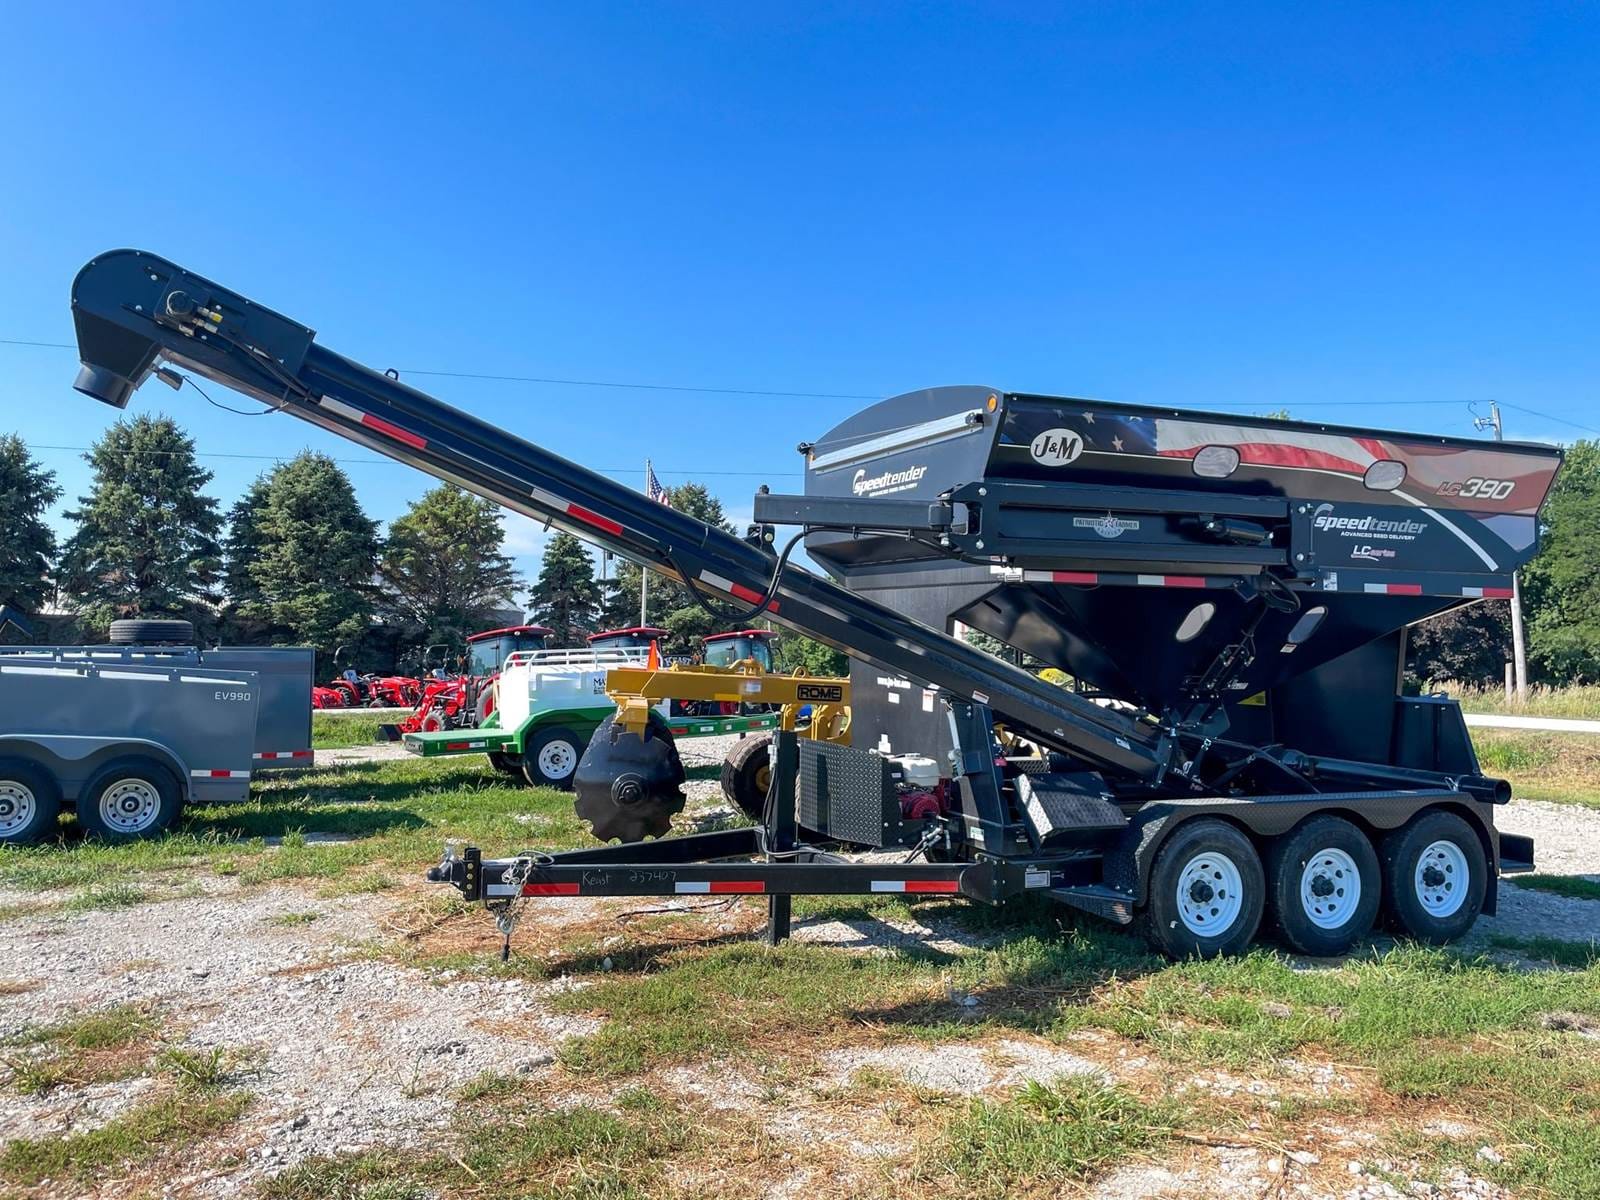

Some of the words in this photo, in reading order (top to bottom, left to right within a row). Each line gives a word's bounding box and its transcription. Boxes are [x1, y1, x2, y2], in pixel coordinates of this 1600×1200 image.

[1034, 435, 1078, 460] J&M
[214, 691, 251, 701] EV990
[800, 686, 841, 699] ROME
